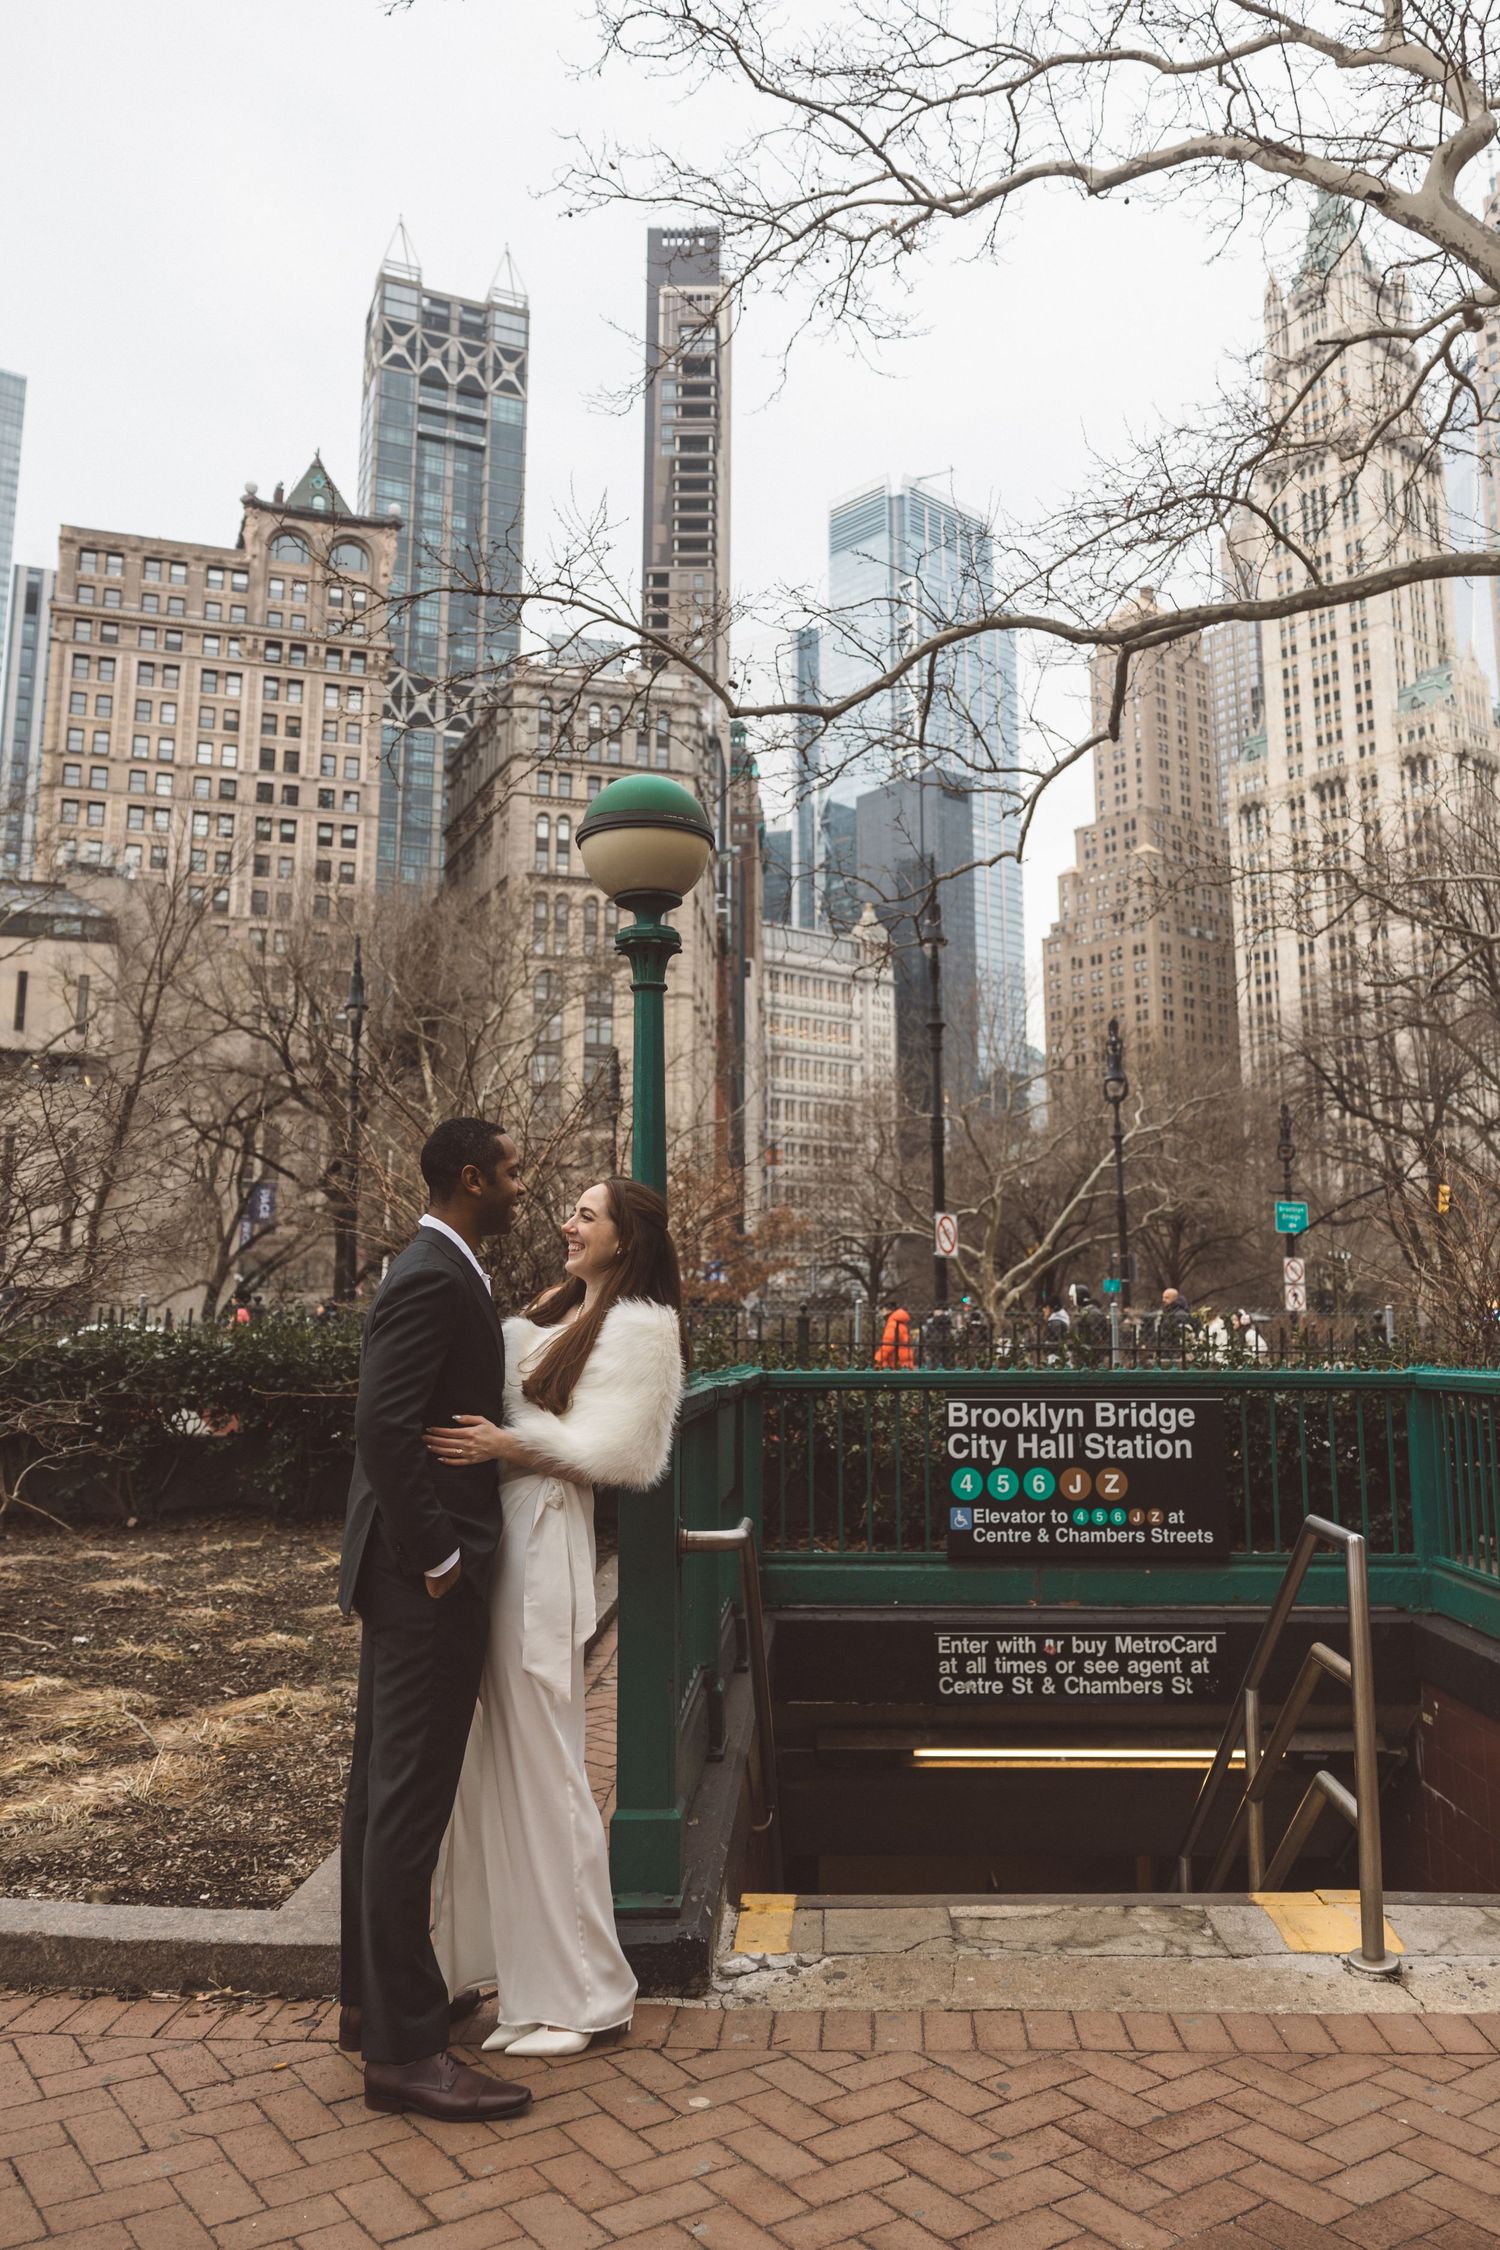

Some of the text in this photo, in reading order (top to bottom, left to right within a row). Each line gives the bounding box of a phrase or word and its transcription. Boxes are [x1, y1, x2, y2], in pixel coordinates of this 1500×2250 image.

[947, 1401, 1196, 1435] Brooklyn Bridge
[947, 1432, 1193, 1466] City Hall Station
[960, 1473, 1120, 1494] 4 5 6 J Z
[973, 1508, 1046, 1524] Elevator
[1050, 1509, 1069, 1524] to
[1168, 1509, 1185, 1525] at
[973, 1527, 1214, 1544] Centre & Chambers Streets
[938, 1636, 990, 1654] Enter
[996, 1636, 1037, 1654] with
[1071, 1635, 1108, 1657] buy
[1114, 1635, 1217, 1654] MetroCard
[938, 1656, 1210, 1678] at all times or see agent at
[939, 1675, 1194, 1695] Centre St & Chambers St
